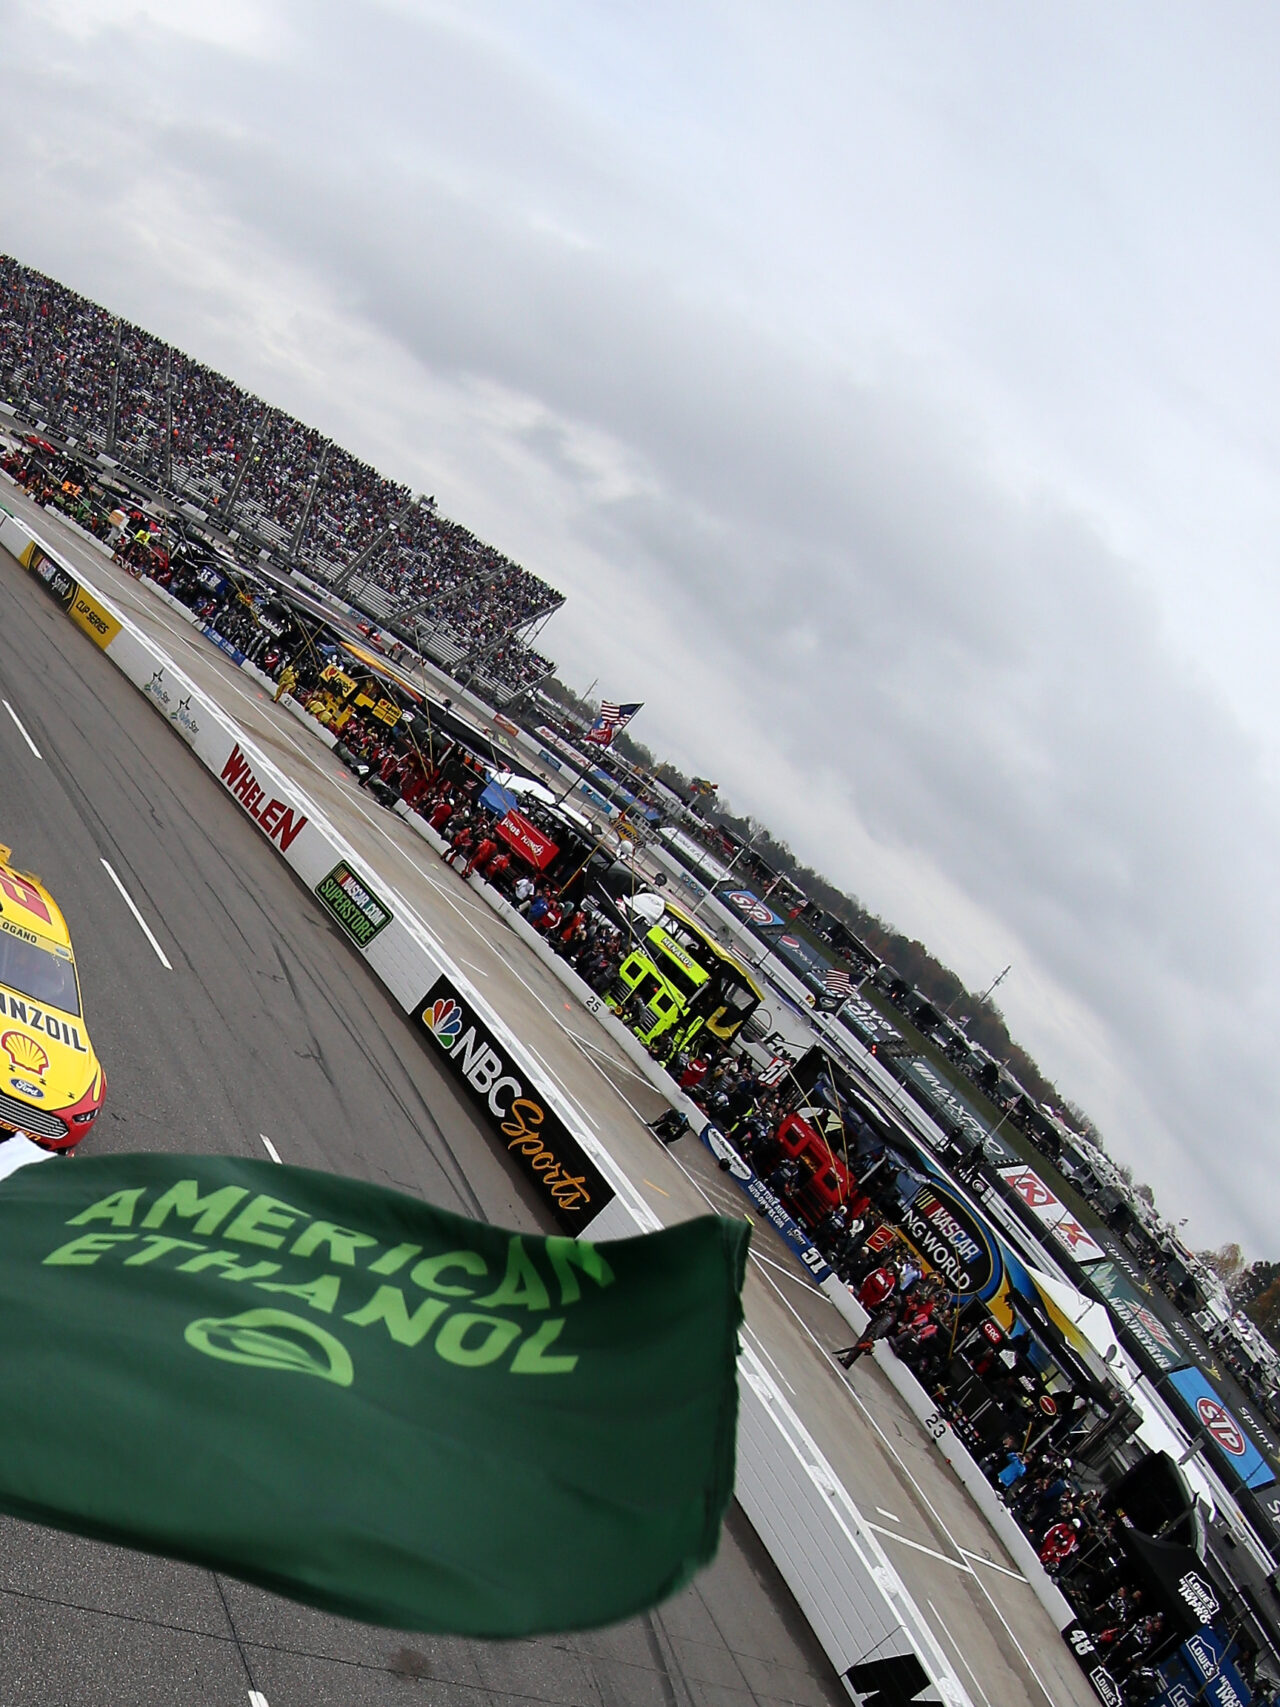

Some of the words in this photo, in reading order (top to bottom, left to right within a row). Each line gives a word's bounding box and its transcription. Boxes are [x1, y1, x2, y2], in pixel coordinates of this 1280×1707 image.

[36, 558, 57, 582] NASCAR
[51, 573, 70, 596] Sprint
[75, 600, 91, 614] CUP
[86, 611, 110, 635] SERIES
[220, 742, 309, 853] WHELEN
[320, 878, 375, 942] SUPERSTORE
[730, 893, 769, 922] STP
[661, 937, 695, 968] MENARDS
[584, 995, 603, 1014] 25
[449, 1025, 523, 1118] NBC
[500, 1098, 591, 1211] Sports
[65, 1179, 616, 1310] AMERICAN
[928, 1206, 982, 1264] NASCAR
[801, 1246, 828, 1275] 51
[922, 1231, 971, 1290] WORLD
[1103, 1240, 1140, 1280] Sprint
[41, 1232, 581, 1376] ETHANOL
[1108, 1296, 1172, 1370] MOUNTAIN
[1170, 1319, 1208, 1362] Sprint
[924, 1413, 947, 1439] 23
[1200, 1405, 1240, 1449] STP
[1238, 1405, 1275, 1450] Sprint
[1187, 1575, 1216, 1611] LOWE'S
[1069, 1629, 1095, 1656] 48
[1190, 1640, 1214, 1677] LOWE'S
[1094, 1671, 1118, 1706] LOWE'S
